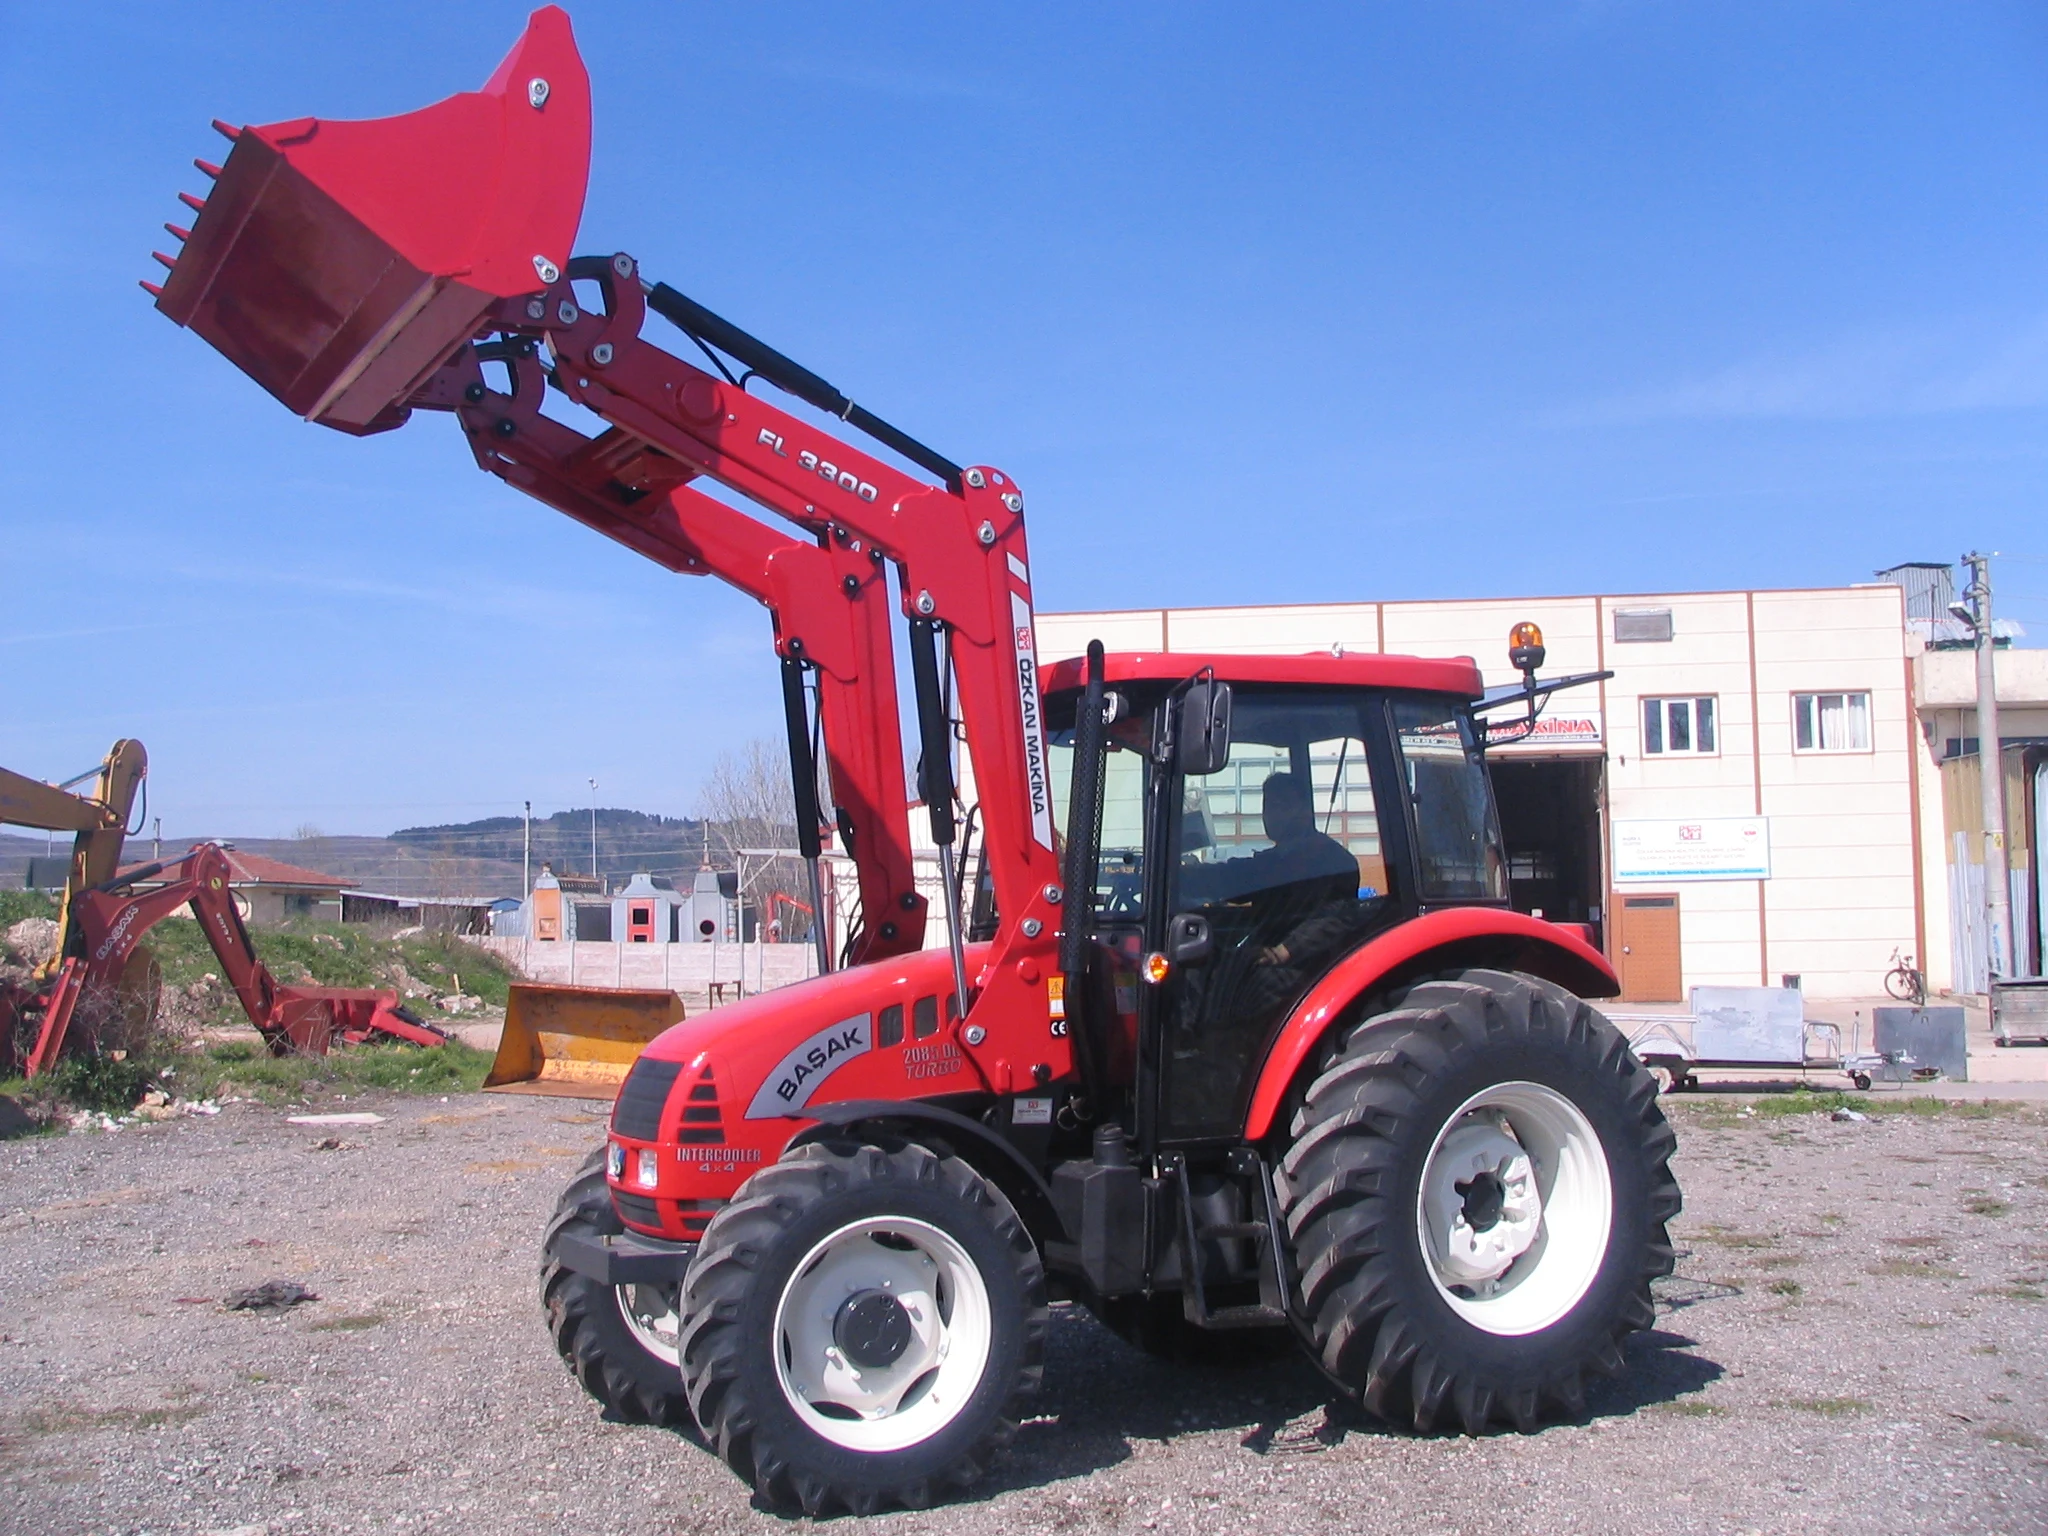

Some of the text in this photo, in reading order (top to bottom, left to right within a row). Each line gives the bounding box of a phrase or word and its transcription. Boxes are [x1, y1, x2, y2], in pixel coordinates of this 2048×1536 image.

[758, 428, 878, 503] FL 3300
[1019, 658, 1045, 816] ÖZKAN MAKİNA
[1051, 1021, 1067, 1036] CE
[776, 1027, 864, 1103] BAŞAK
[902, 1045, 940, 1064] 2085
[905, 1058, 961, 1080] TURBO
[676, 1147, 762, 1163] INTERCOOLER
